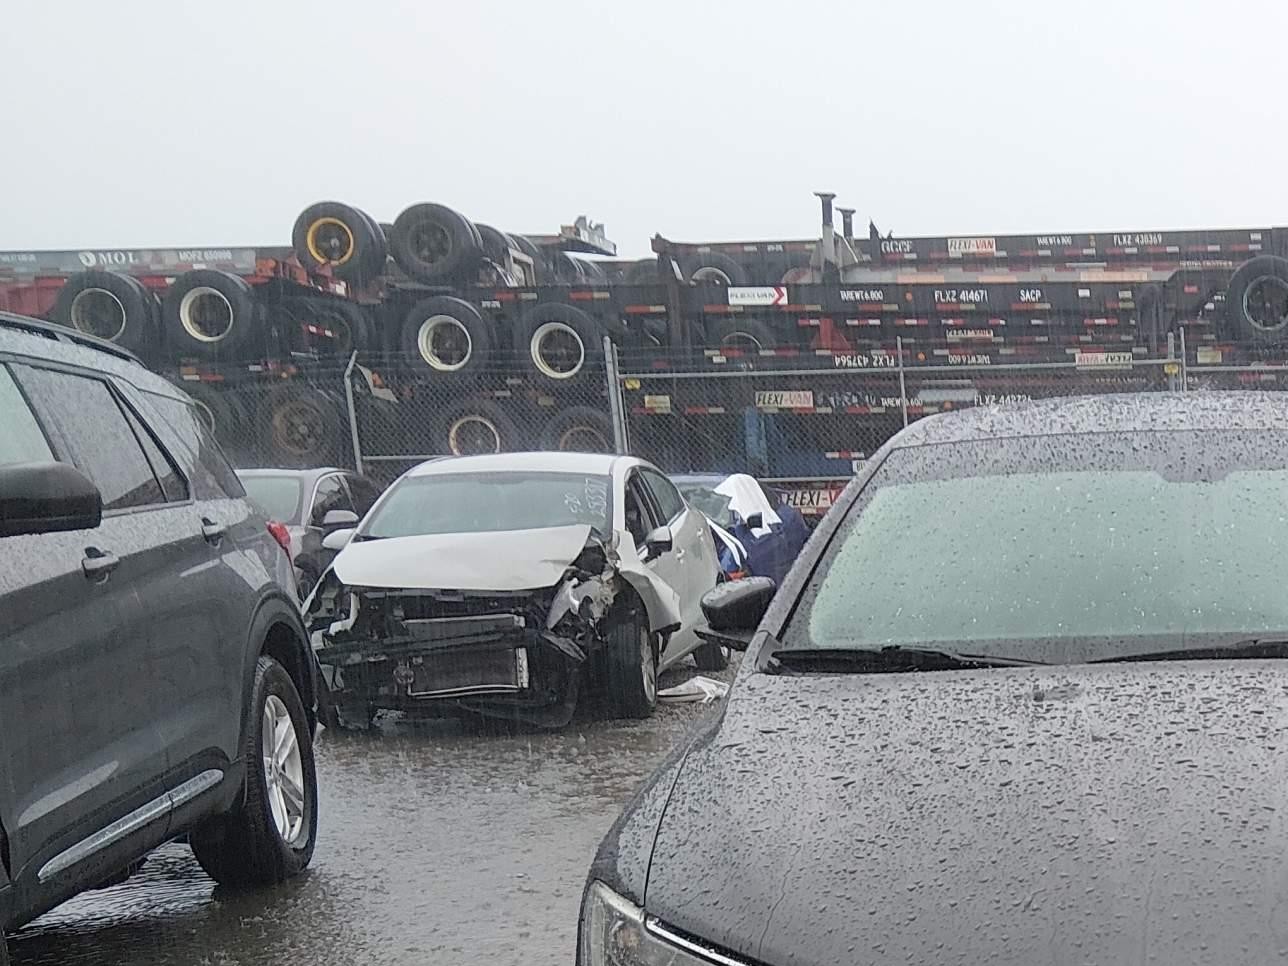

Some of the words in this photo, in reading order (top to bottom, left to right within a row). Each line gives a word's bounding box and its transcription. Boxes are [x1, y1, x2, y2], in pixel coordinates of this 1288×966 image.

[1113, 235, 1132, 246] FLXZ
[935, 290, 957, 302] FLXZ
[959, 289, 988, 303] 414671
[1020, 290, 1041, 302] SACP
[872, 355, 895, 367] FLXZ
